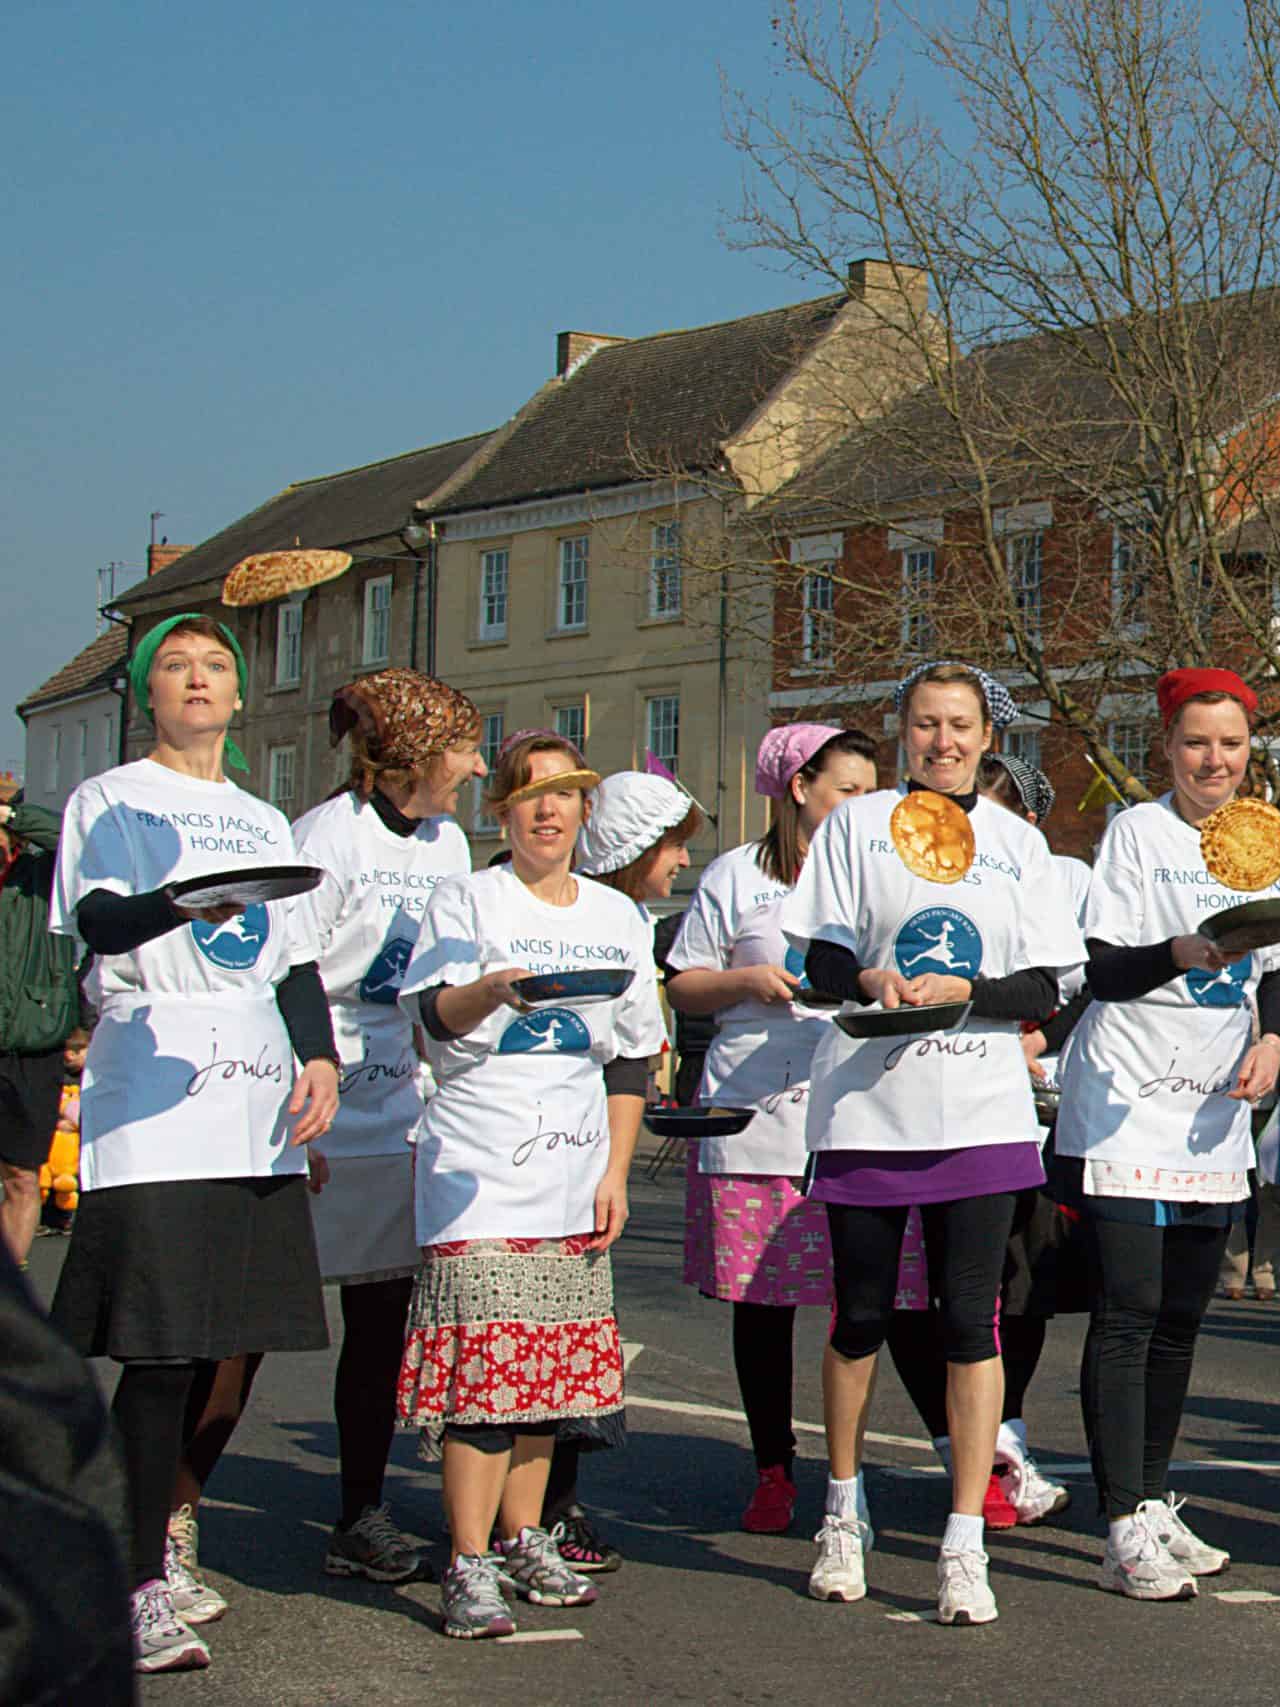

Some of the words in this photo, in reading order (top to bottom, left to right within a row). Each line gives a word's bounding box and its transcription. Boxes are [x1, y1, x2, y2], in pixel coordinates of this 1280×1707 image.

[136, 812, 214, 829] FRANCIS
[190, 834, 257, 855] HOMES
[186, 1027, 282, 1097] joules
[1138, 1046, 1231, 1098] joules
[512, 1100, 601, 1167] joules
